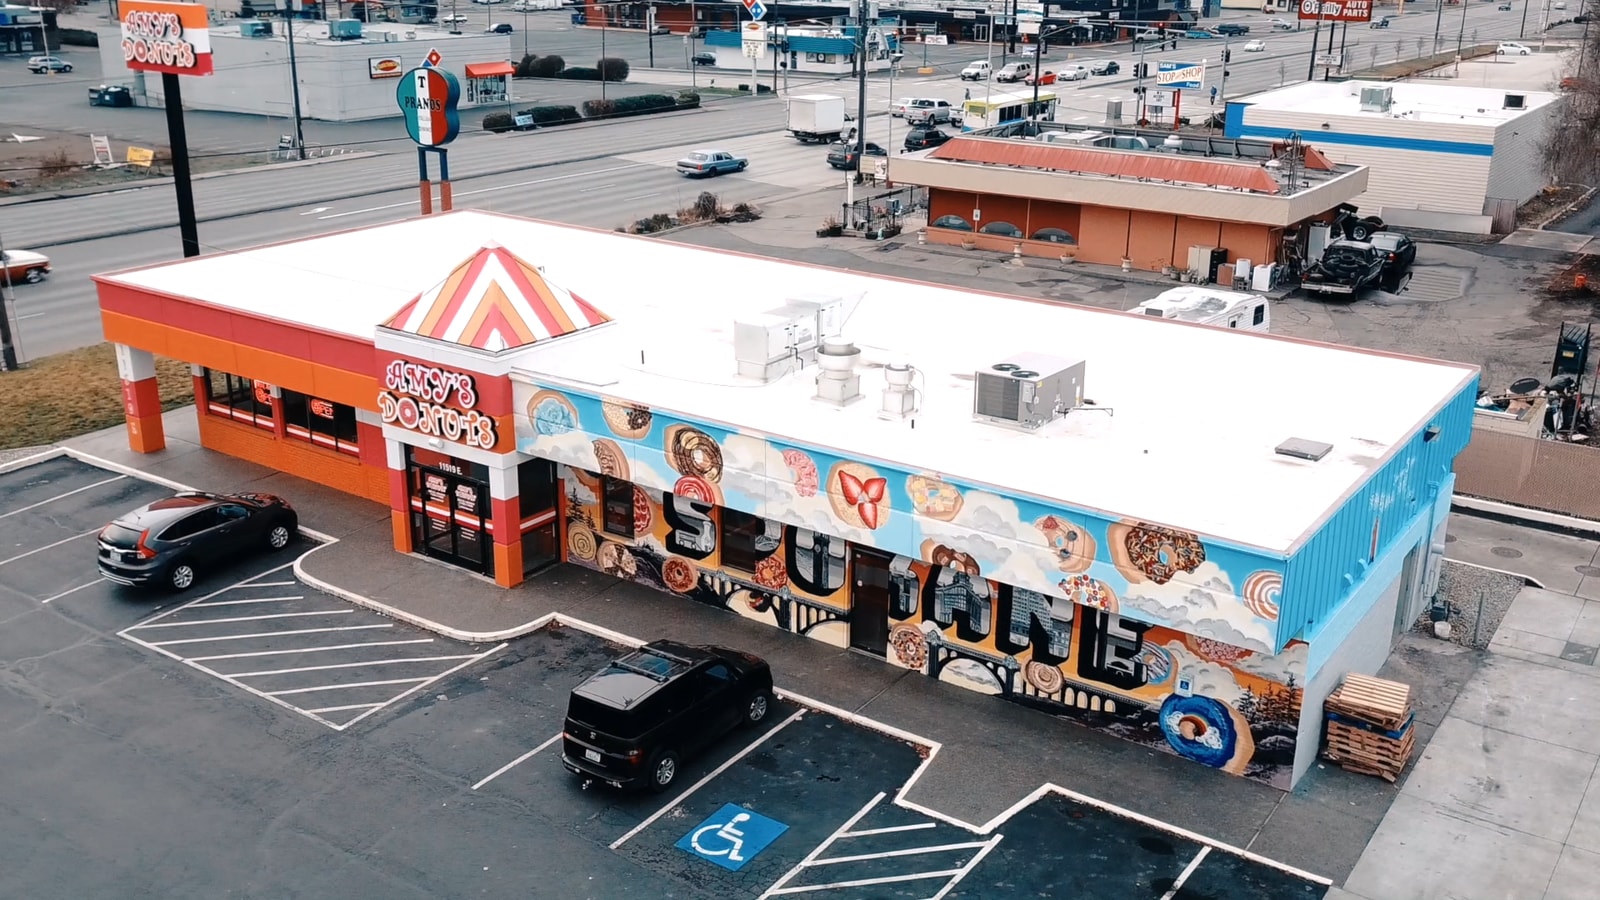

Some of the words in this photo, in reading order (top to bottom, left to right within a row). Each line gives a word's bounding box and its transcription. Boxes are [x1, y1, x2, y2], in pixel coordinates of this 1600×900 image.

[1342, 8, 1369, 17] PARTS
[1345, 1, 1368, 9] AUTO
[125, 10, 181, 39] AMY'S
[121, 38, 195, 68] DONUTS
[417, 75, 426, 88] T
[1157, 71, 1176, 83] STOP
[1181, 67, 1202, 80] SHOP
[386, 360, 475, 409] AMY'S
[377, 391, 496, 450] DONUTS
[438, 461, 457, 474] 11519
[663, 491, 1150, 691] SOANE
